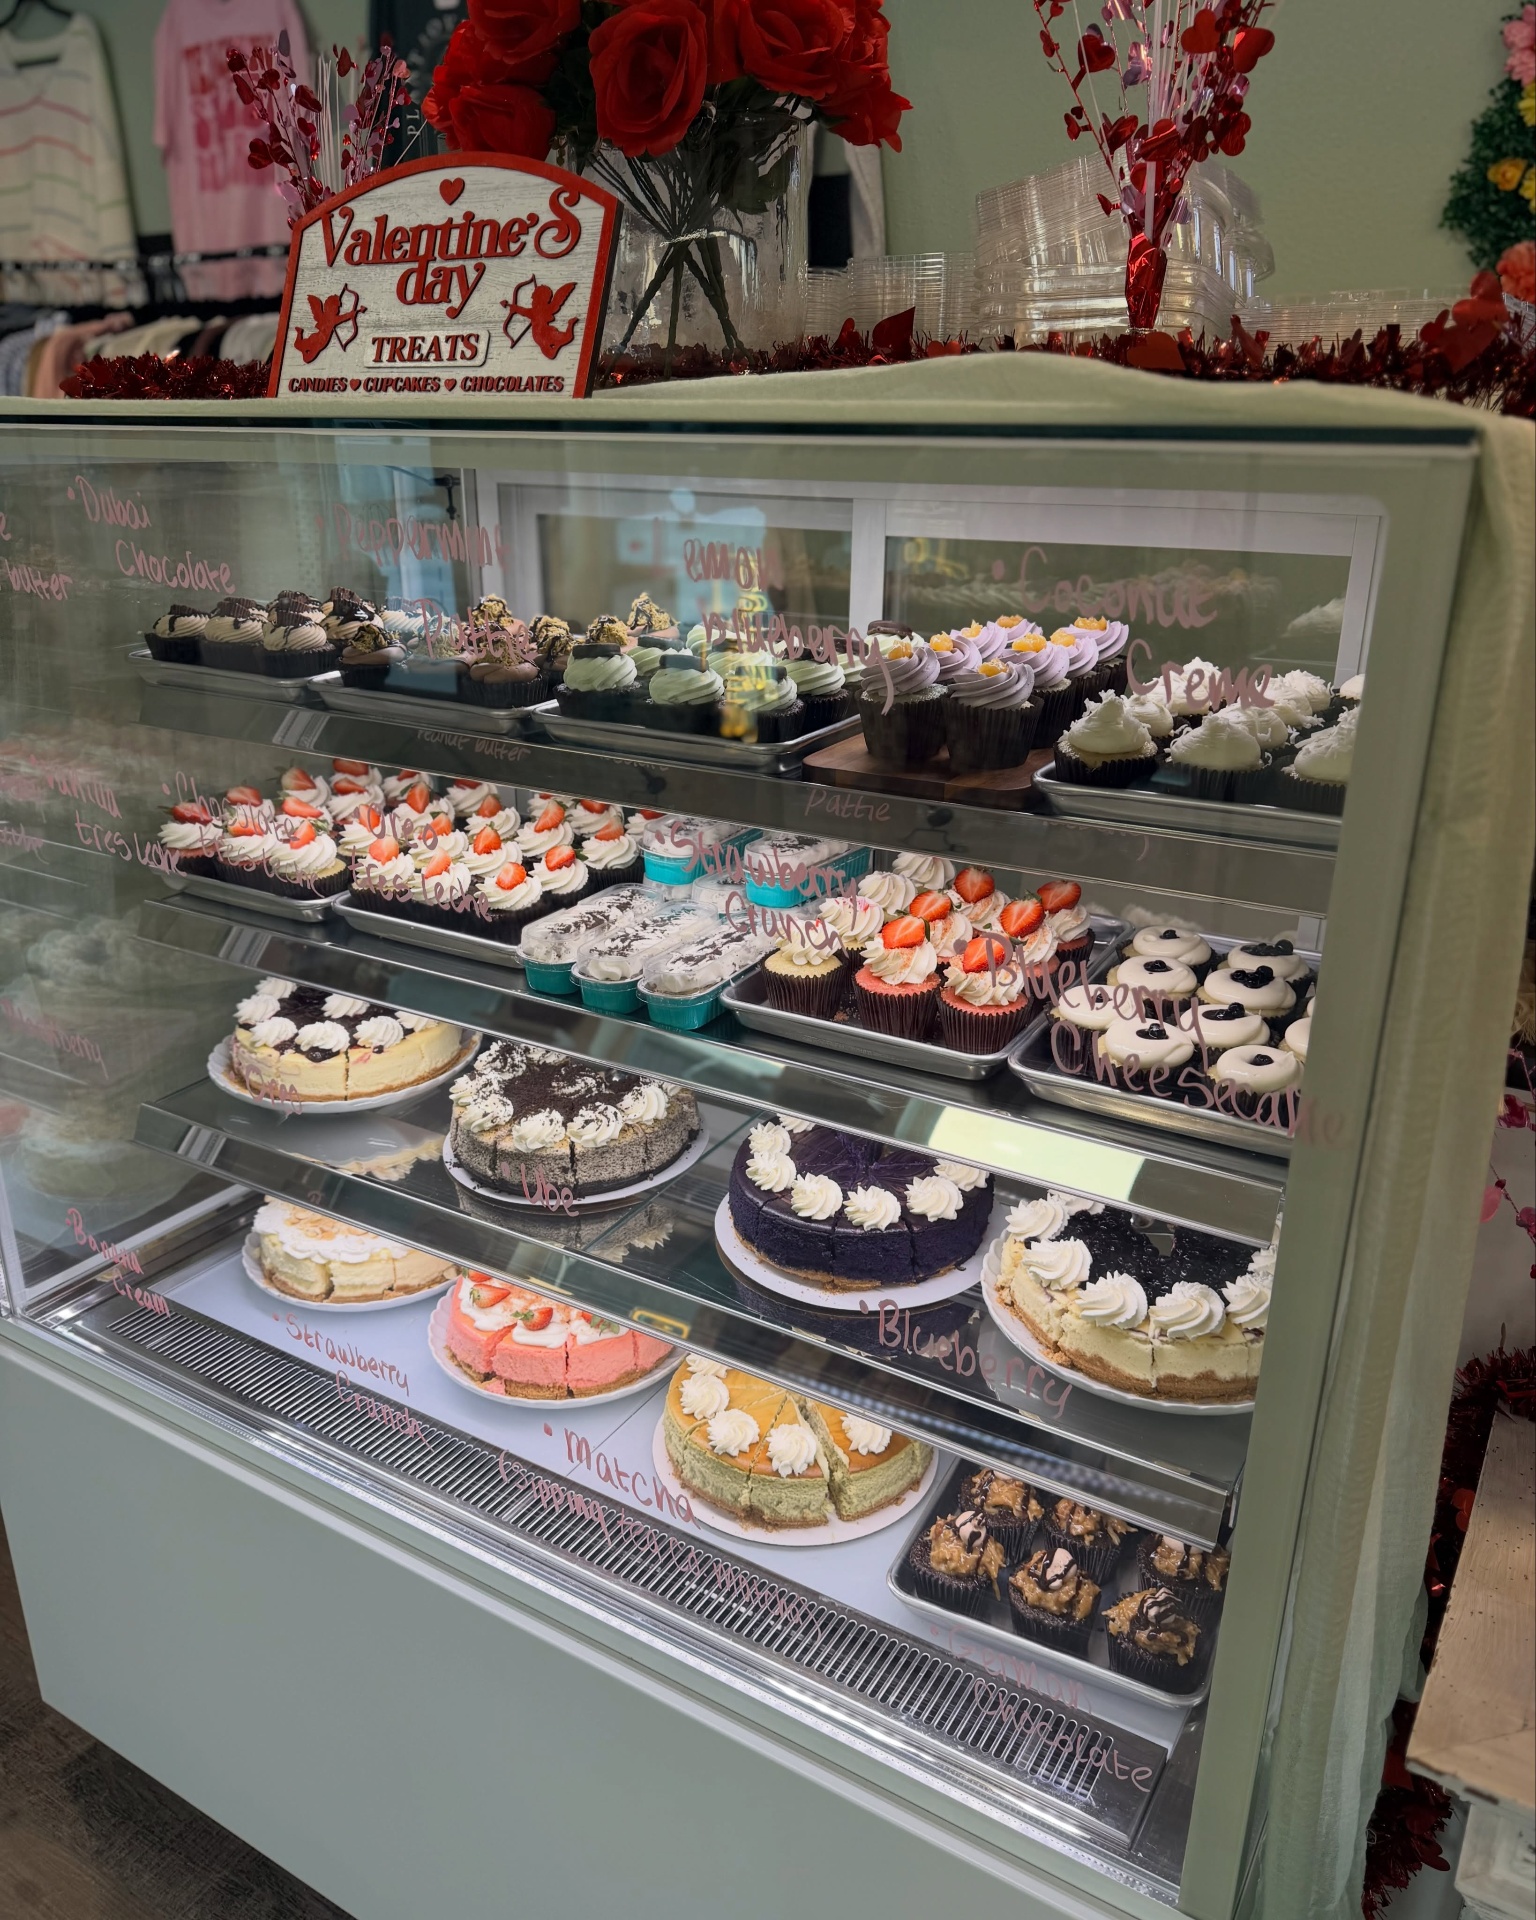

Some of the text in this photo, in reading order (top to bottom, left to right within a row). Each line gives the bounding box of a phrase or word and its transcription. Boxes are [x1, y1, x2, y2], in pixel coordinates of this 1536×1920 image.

[396, 260, 486, 319] day
[371, 333, 480, 363] TREATS
[288, 375, 564, 393] CANDIES CUPCAKES CHOCOLATES
[75, 474, 152, 530] Dubai
[115, 539, 236, 594] Chocolate
[1126, 638, 1275, 710] Creme
[725, 891, 849, 958] Crunch
[984, 932, 1209, 1075] Blueberry
[286, 1312, 410, 1397] Strawberry
[877, 1298, 1073, 1420] Blueberry
